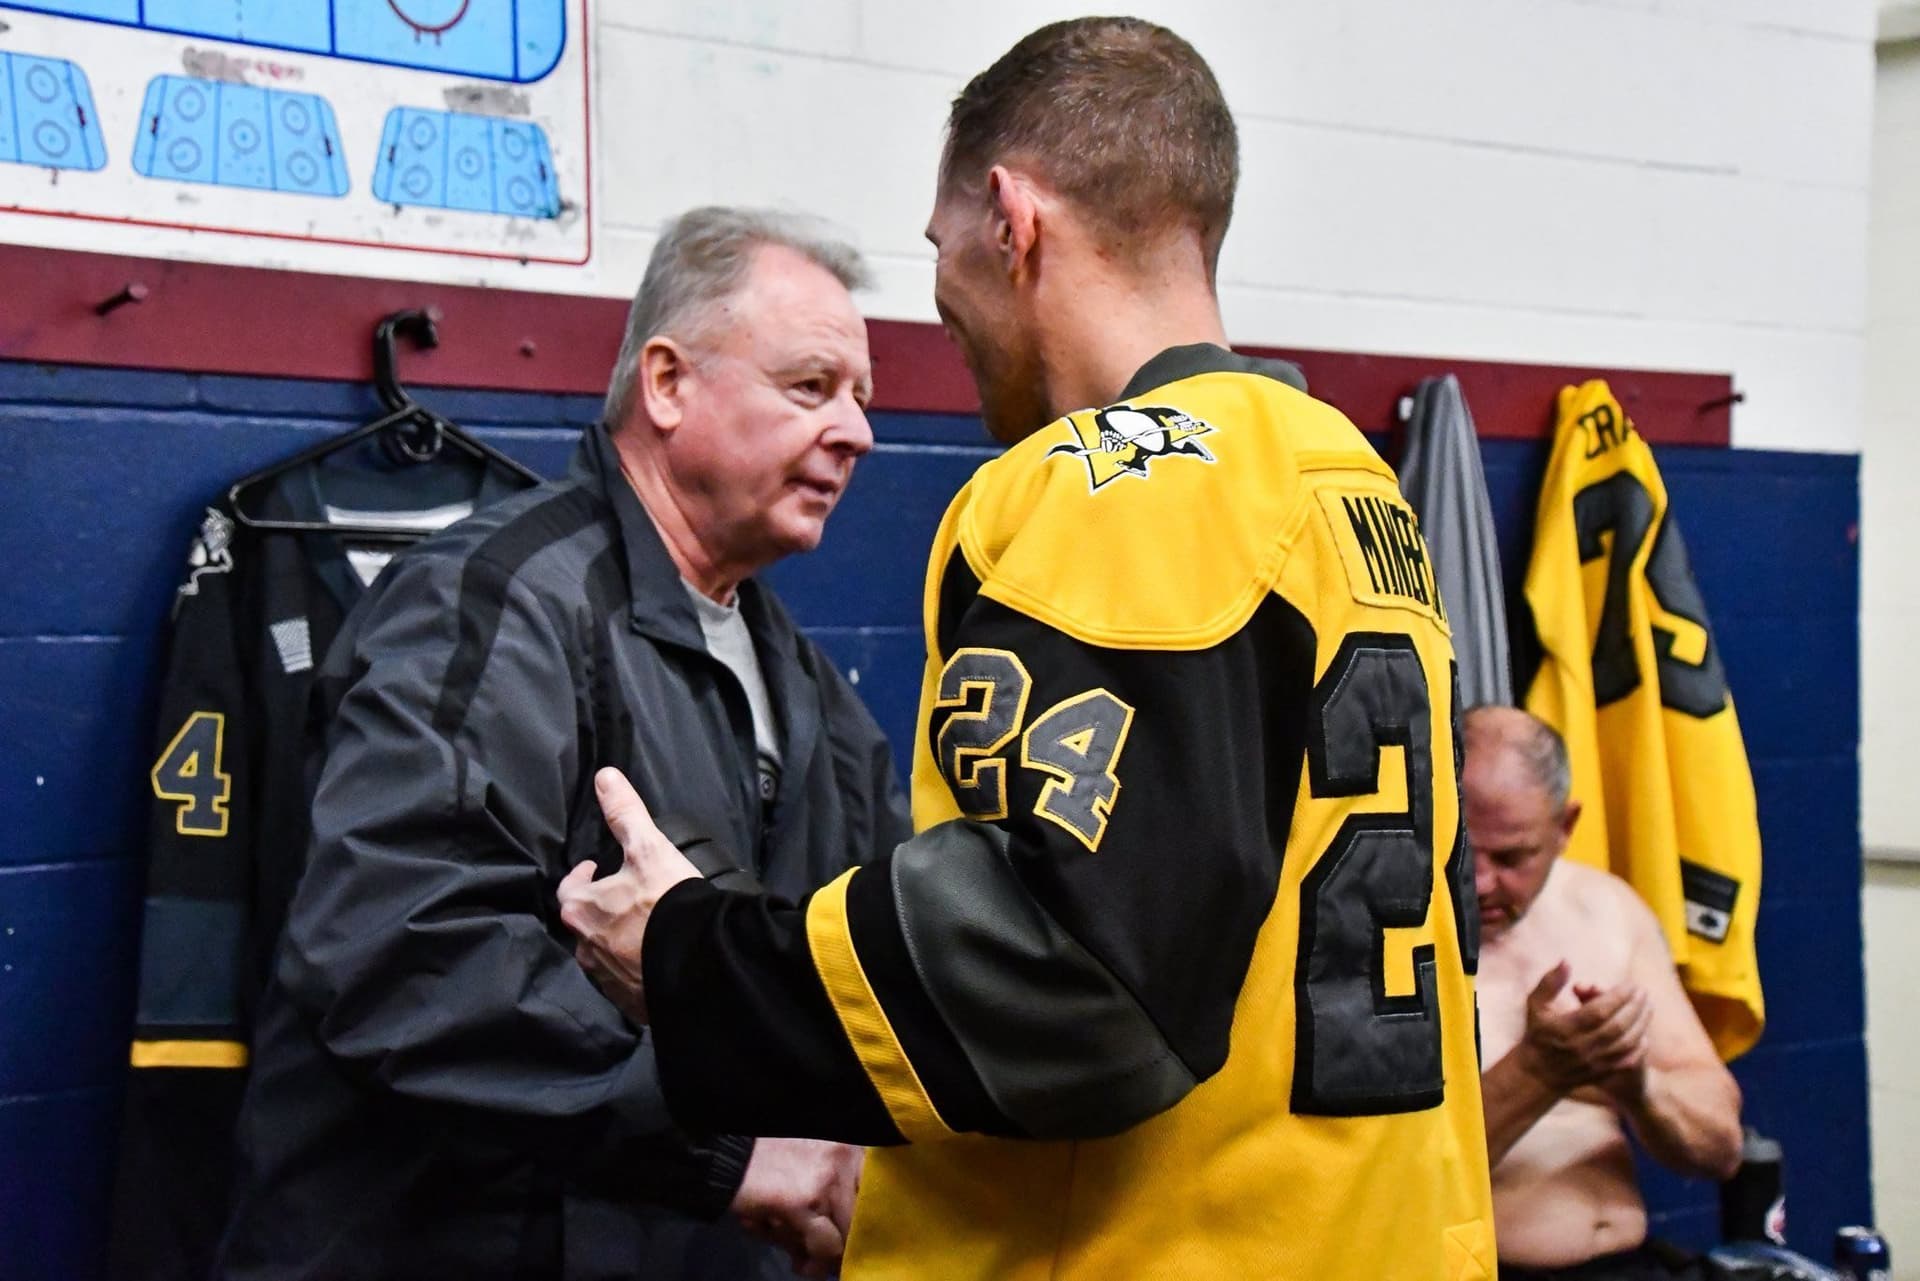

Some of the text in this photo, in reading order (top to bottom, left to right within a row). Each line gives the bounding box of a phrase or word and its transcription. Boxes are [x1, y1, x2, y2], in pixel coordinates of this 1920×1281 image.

[151, 711, 232, 837] 4
[935, 647, 1136, 853] 24
[1290, 631, 1481, 1114] 2
